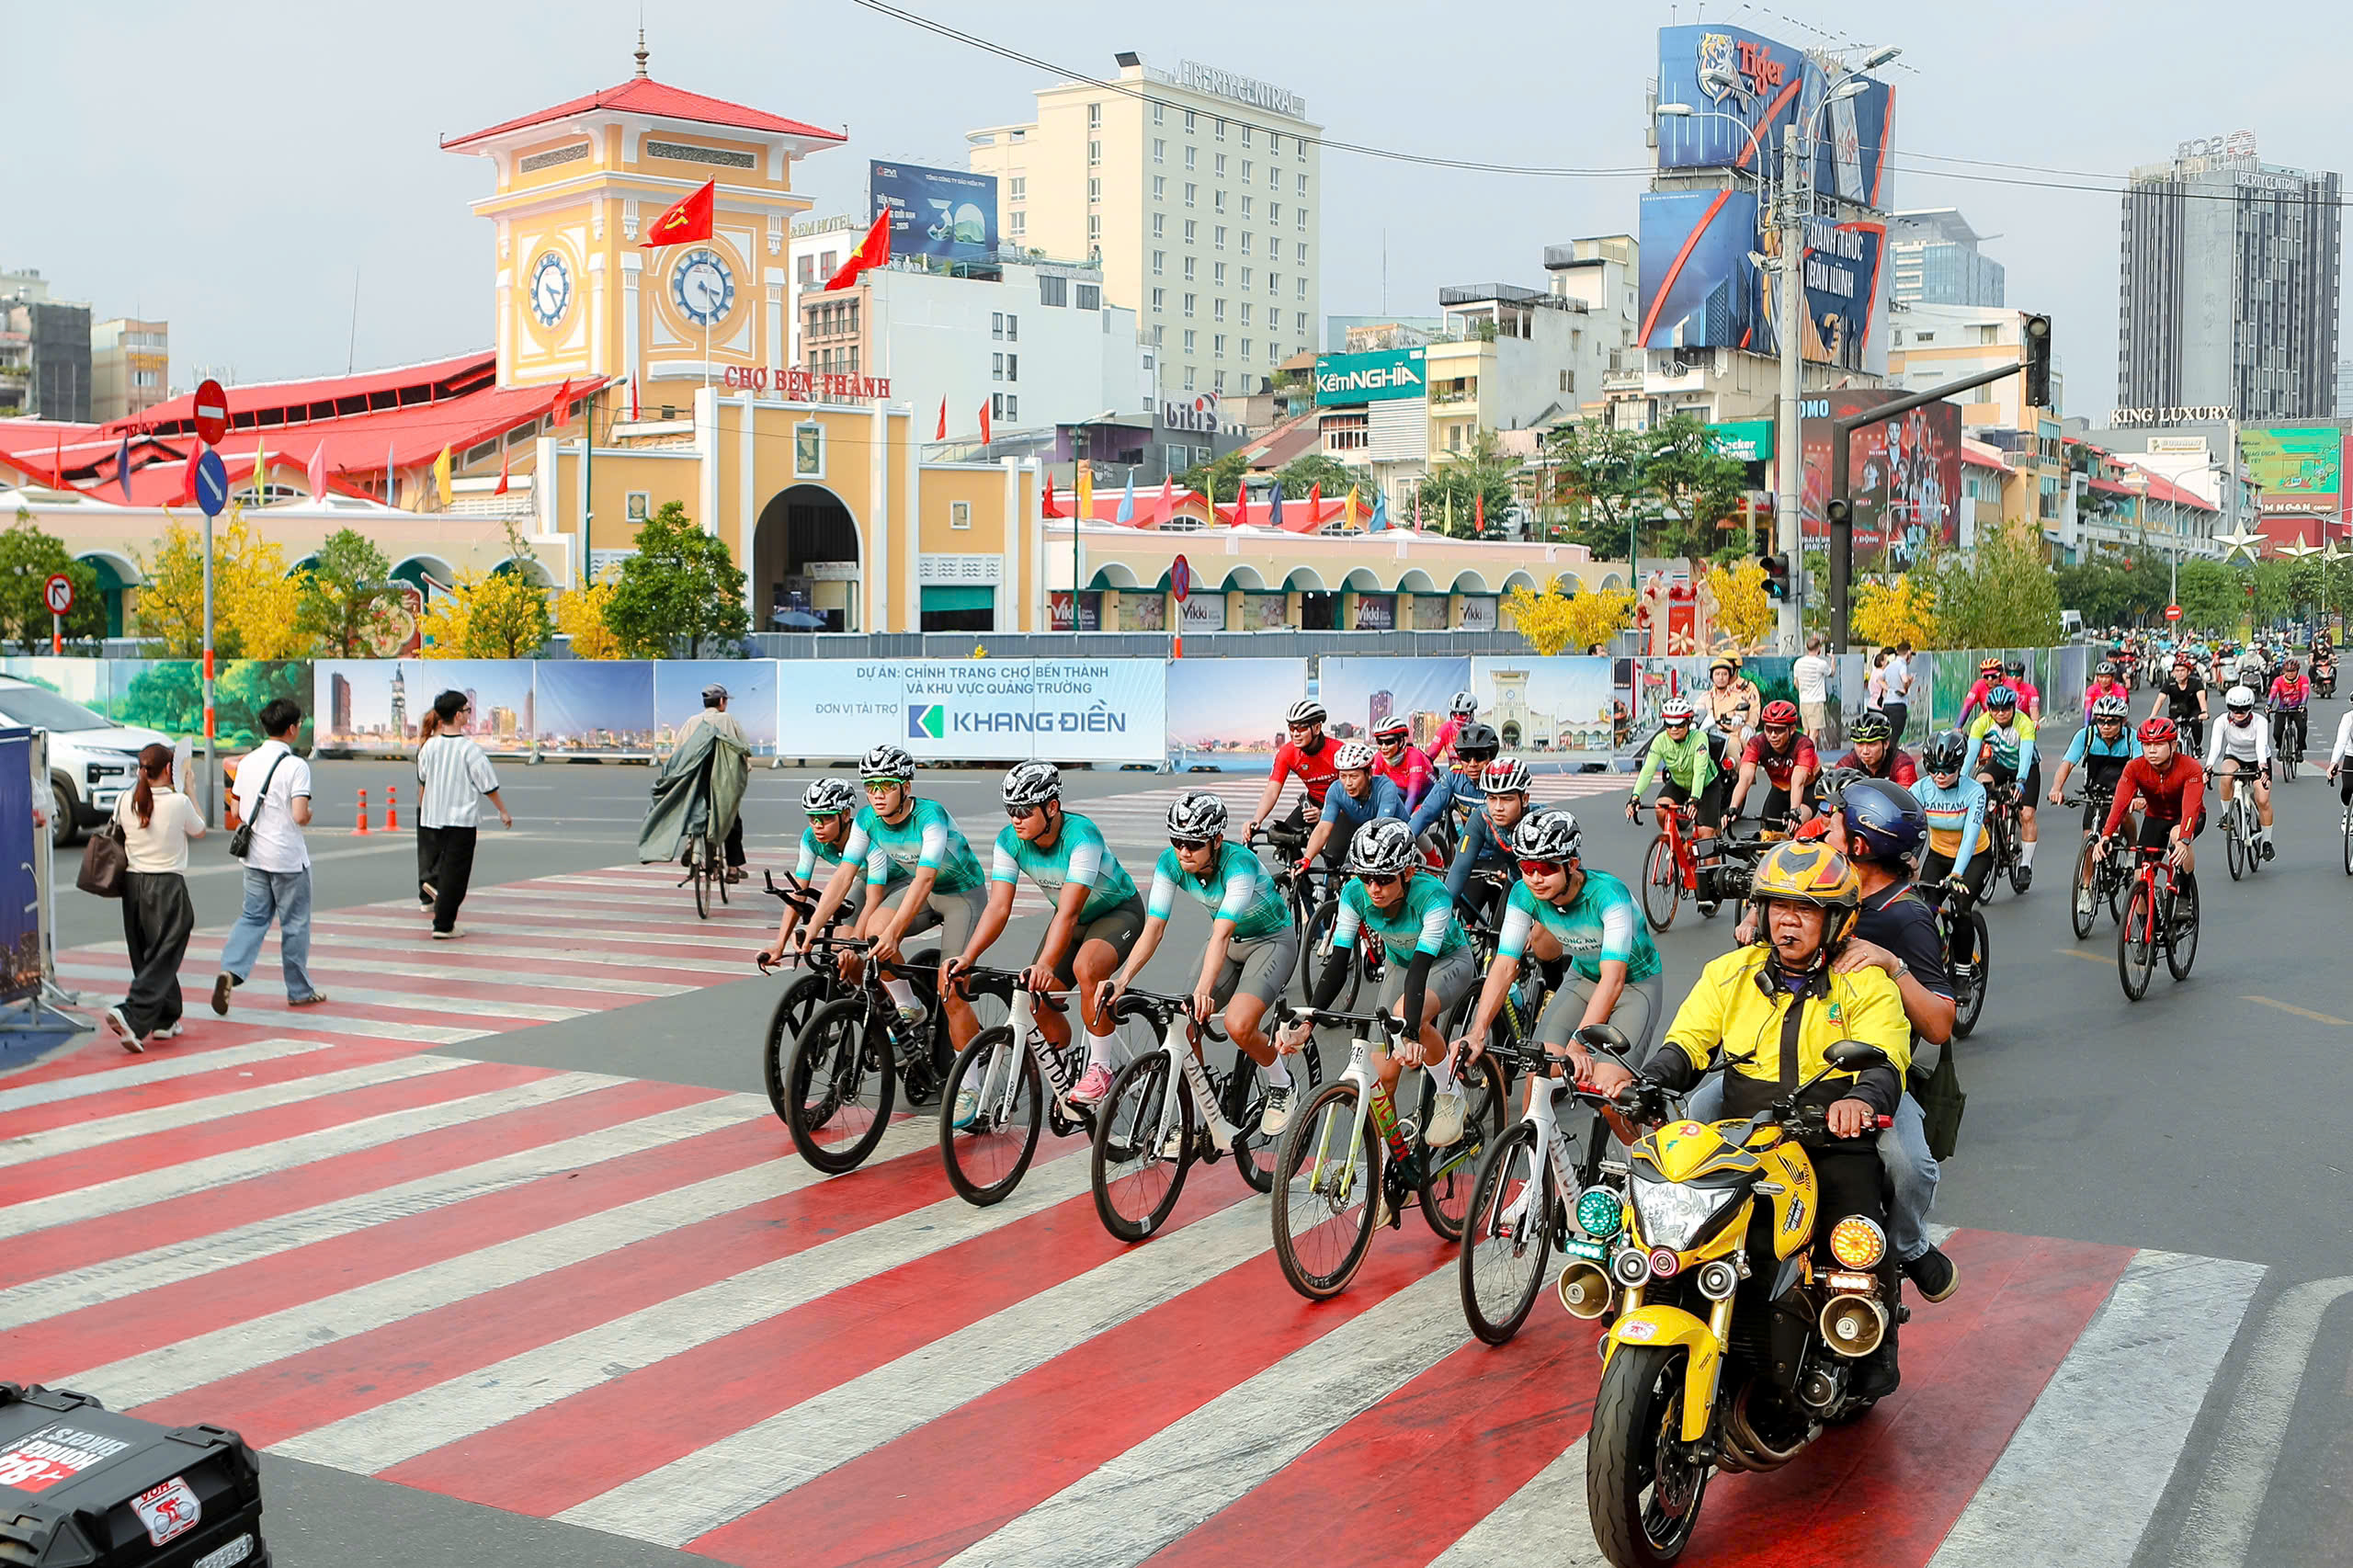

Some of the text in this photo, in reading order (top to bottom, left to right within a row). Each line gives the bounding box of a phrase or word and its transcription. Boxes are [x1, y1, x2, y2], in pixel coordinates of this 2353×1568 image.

[1736, 39, 1786, 96] Tiger
[2235, 171, 2299, 191] LIBERTY CENTRAL
[817, 213, 852, 233] HOTEL
[927, 198, 986, 246] 30
[724, 365, 892, 399] CHỢ BẾN THÀNH
[2110, 404, 2234, 424] KING LUXURY
[1181, 598, 1208, 619] Vikki
[1358, 600, 1380, 621] Vikki
[1464, 602, 1483, 620] Vikki
[857, 662, 1108, 681] DỰ ÁN: CHỈNH TRANG CHỢ BẾN THÀNH
[906, 679, 1092, 699] VÀ KHU VỰC QUẢNG TRƯỜNG
[815, 699, 899, 718] ĐƠN VỊ TÀI TRỢ
[954, 699, 1126, 733] KHANG ĐIỀN
[46, 1427, 130, 1458] Bikers
[18, 1439, 104, 1471] Honda
